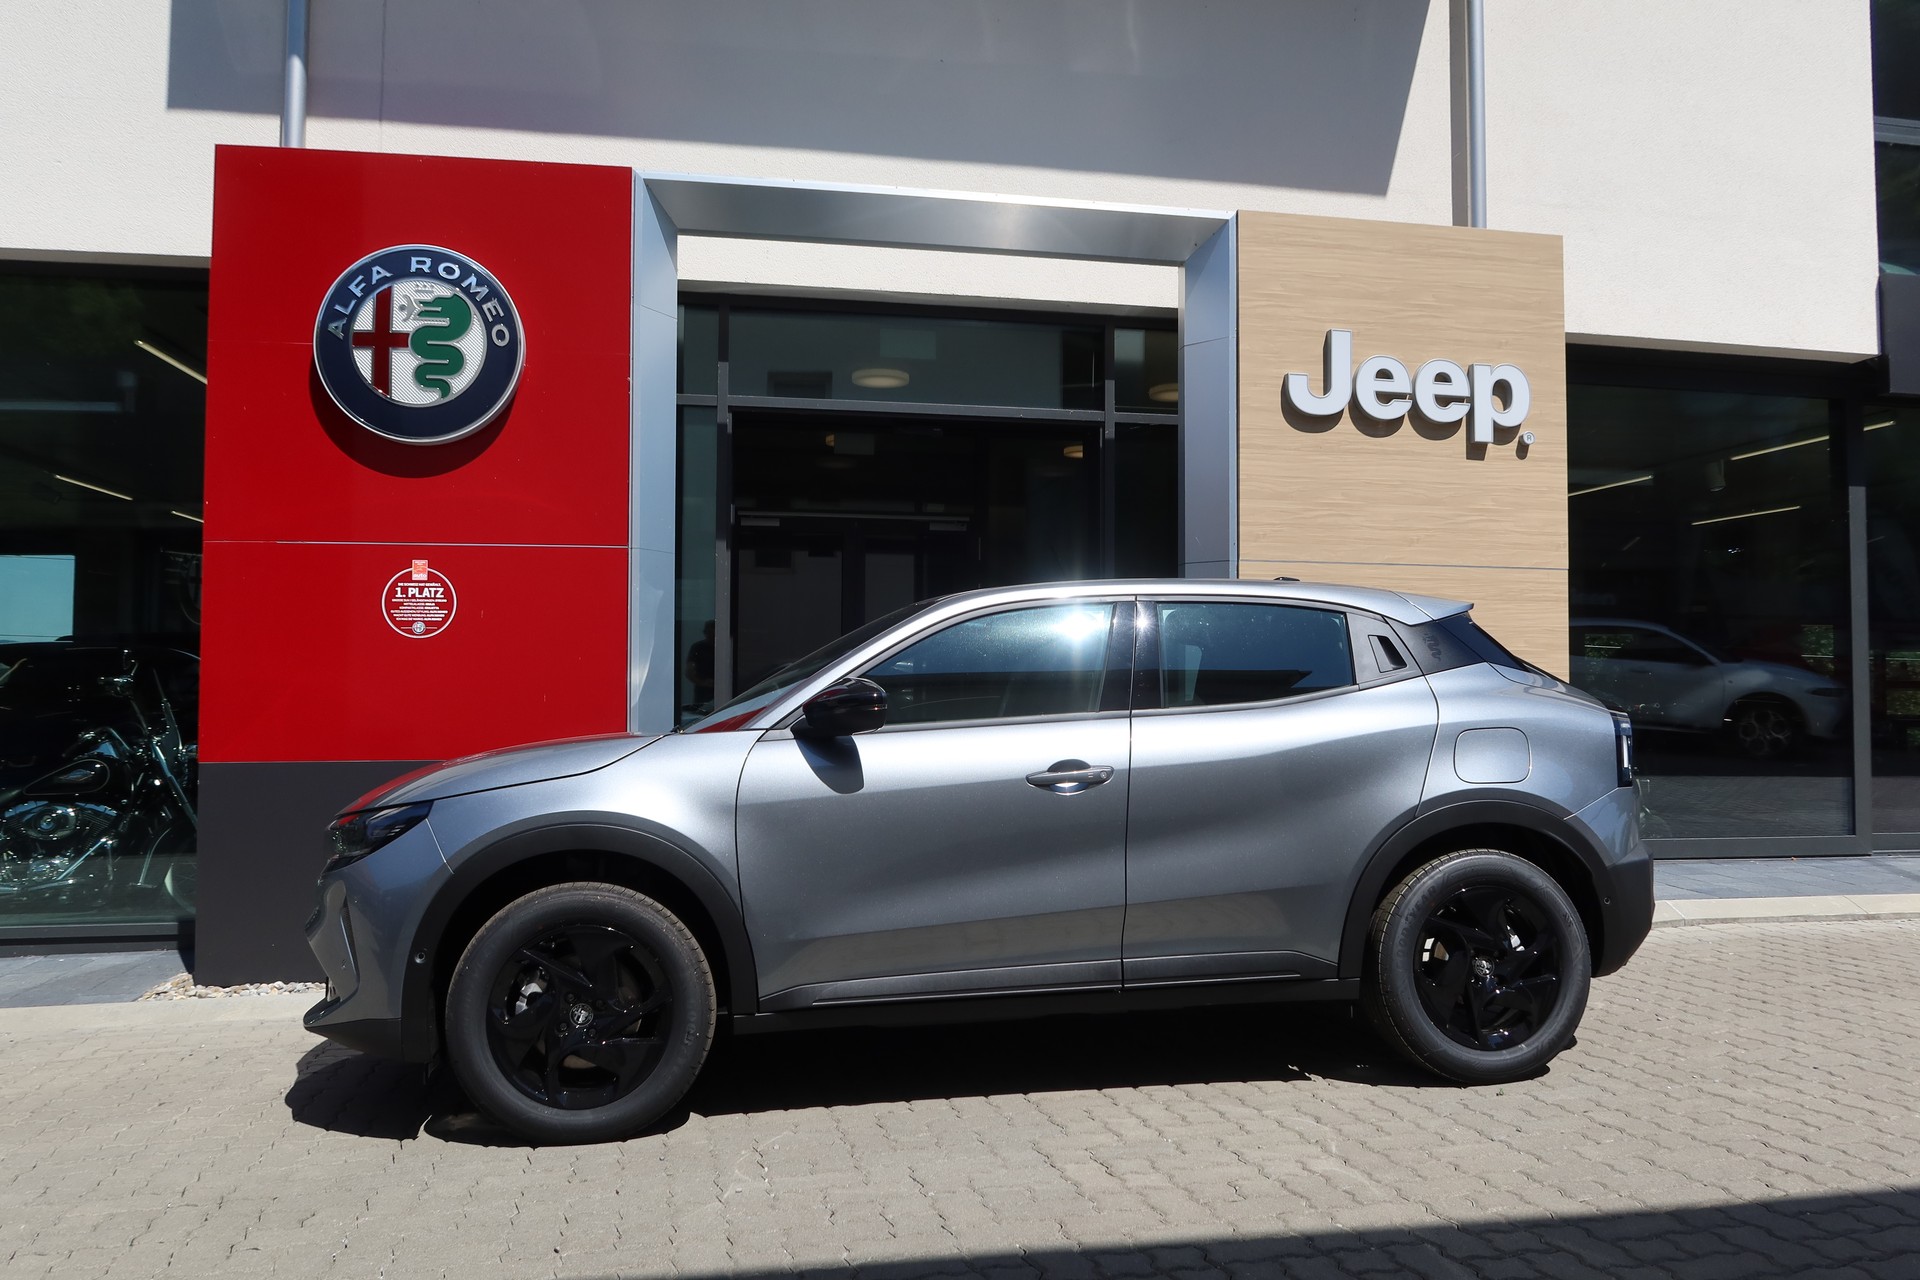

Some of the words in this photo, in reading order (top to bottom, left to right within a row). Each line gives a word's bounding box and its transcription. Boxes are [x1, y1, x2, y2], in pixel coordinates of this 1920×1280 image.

[327, 265, 394, 341] ALFA
[409, 256, 510, 347] ROMEO
[395, 587, 406, 598] 1.
[408, 587, 445, 598] PLATZ
